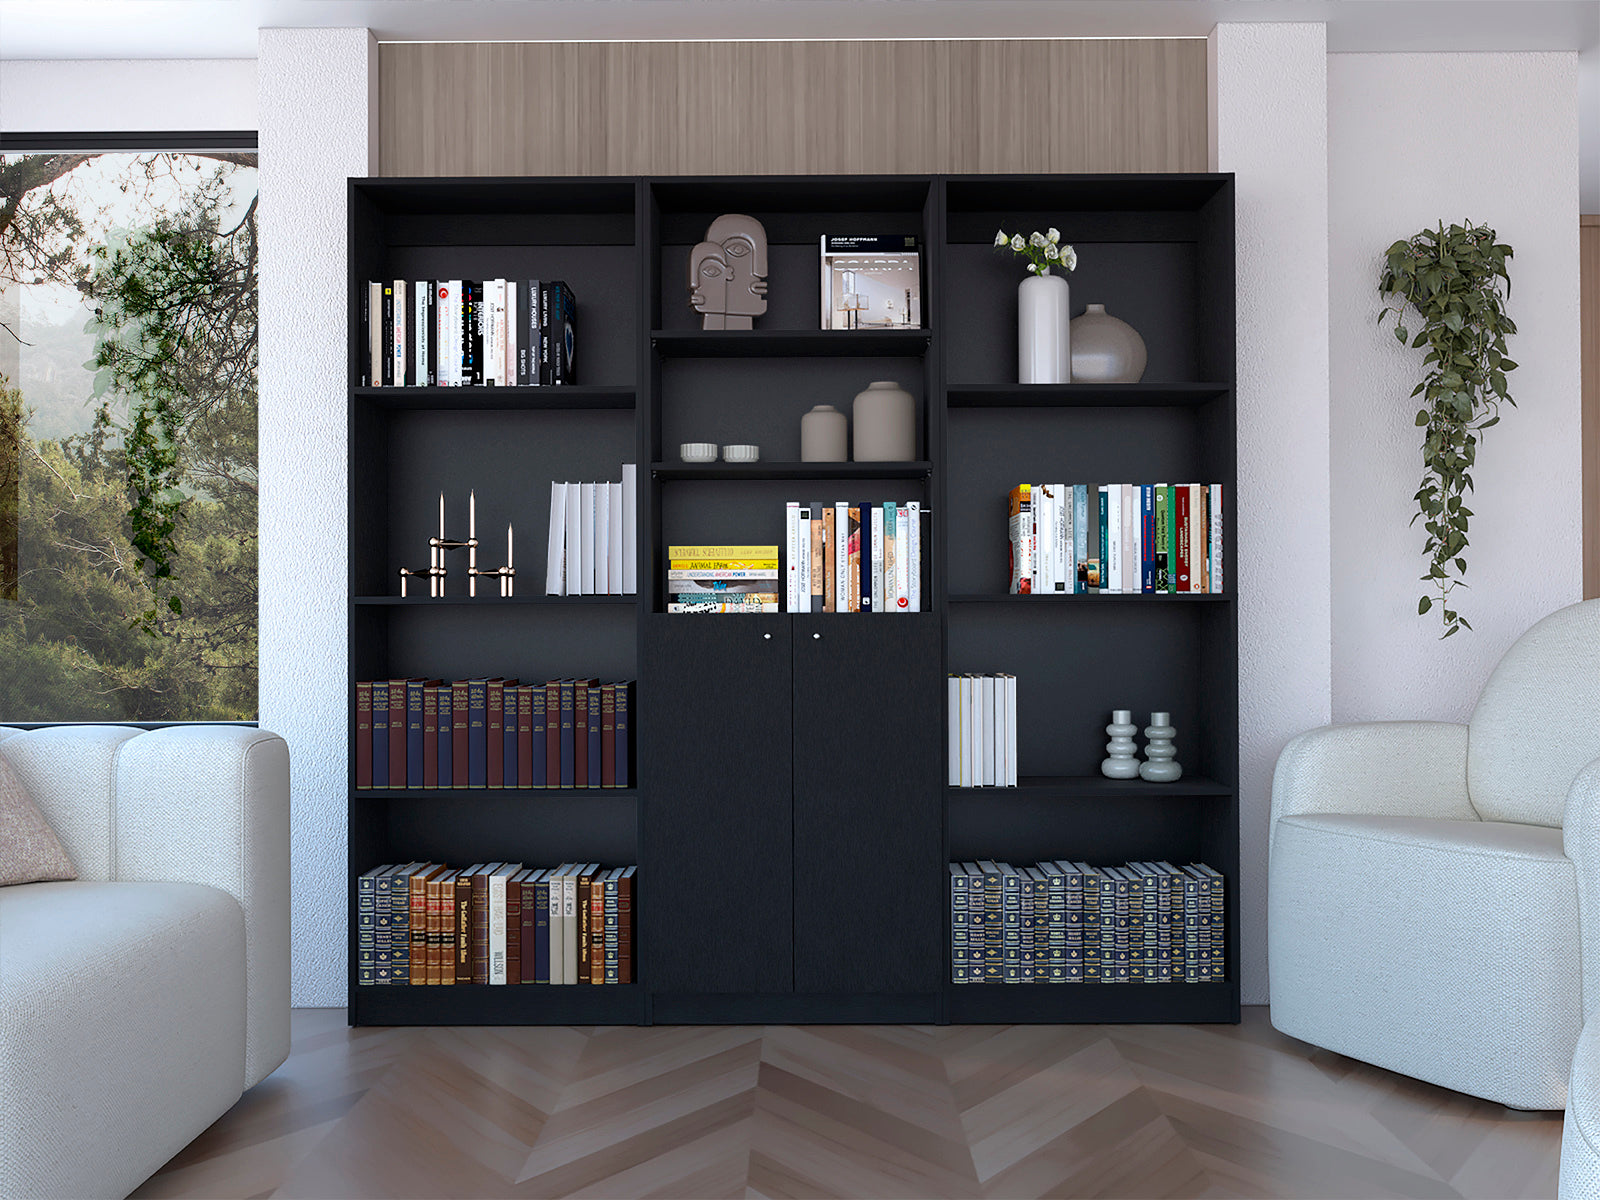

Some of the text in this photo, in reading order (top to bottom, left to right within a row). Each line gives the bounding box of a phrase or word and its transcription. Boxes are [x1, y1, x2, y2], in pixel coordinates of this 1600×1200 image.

[494, 883, 504, 899] EGGS
[460, 900, 468, 909] The
[460, 909, 468, 933] Godfather
[460, 933, 468, 948] Family
[494, 951, 504, 975] WILLSON
